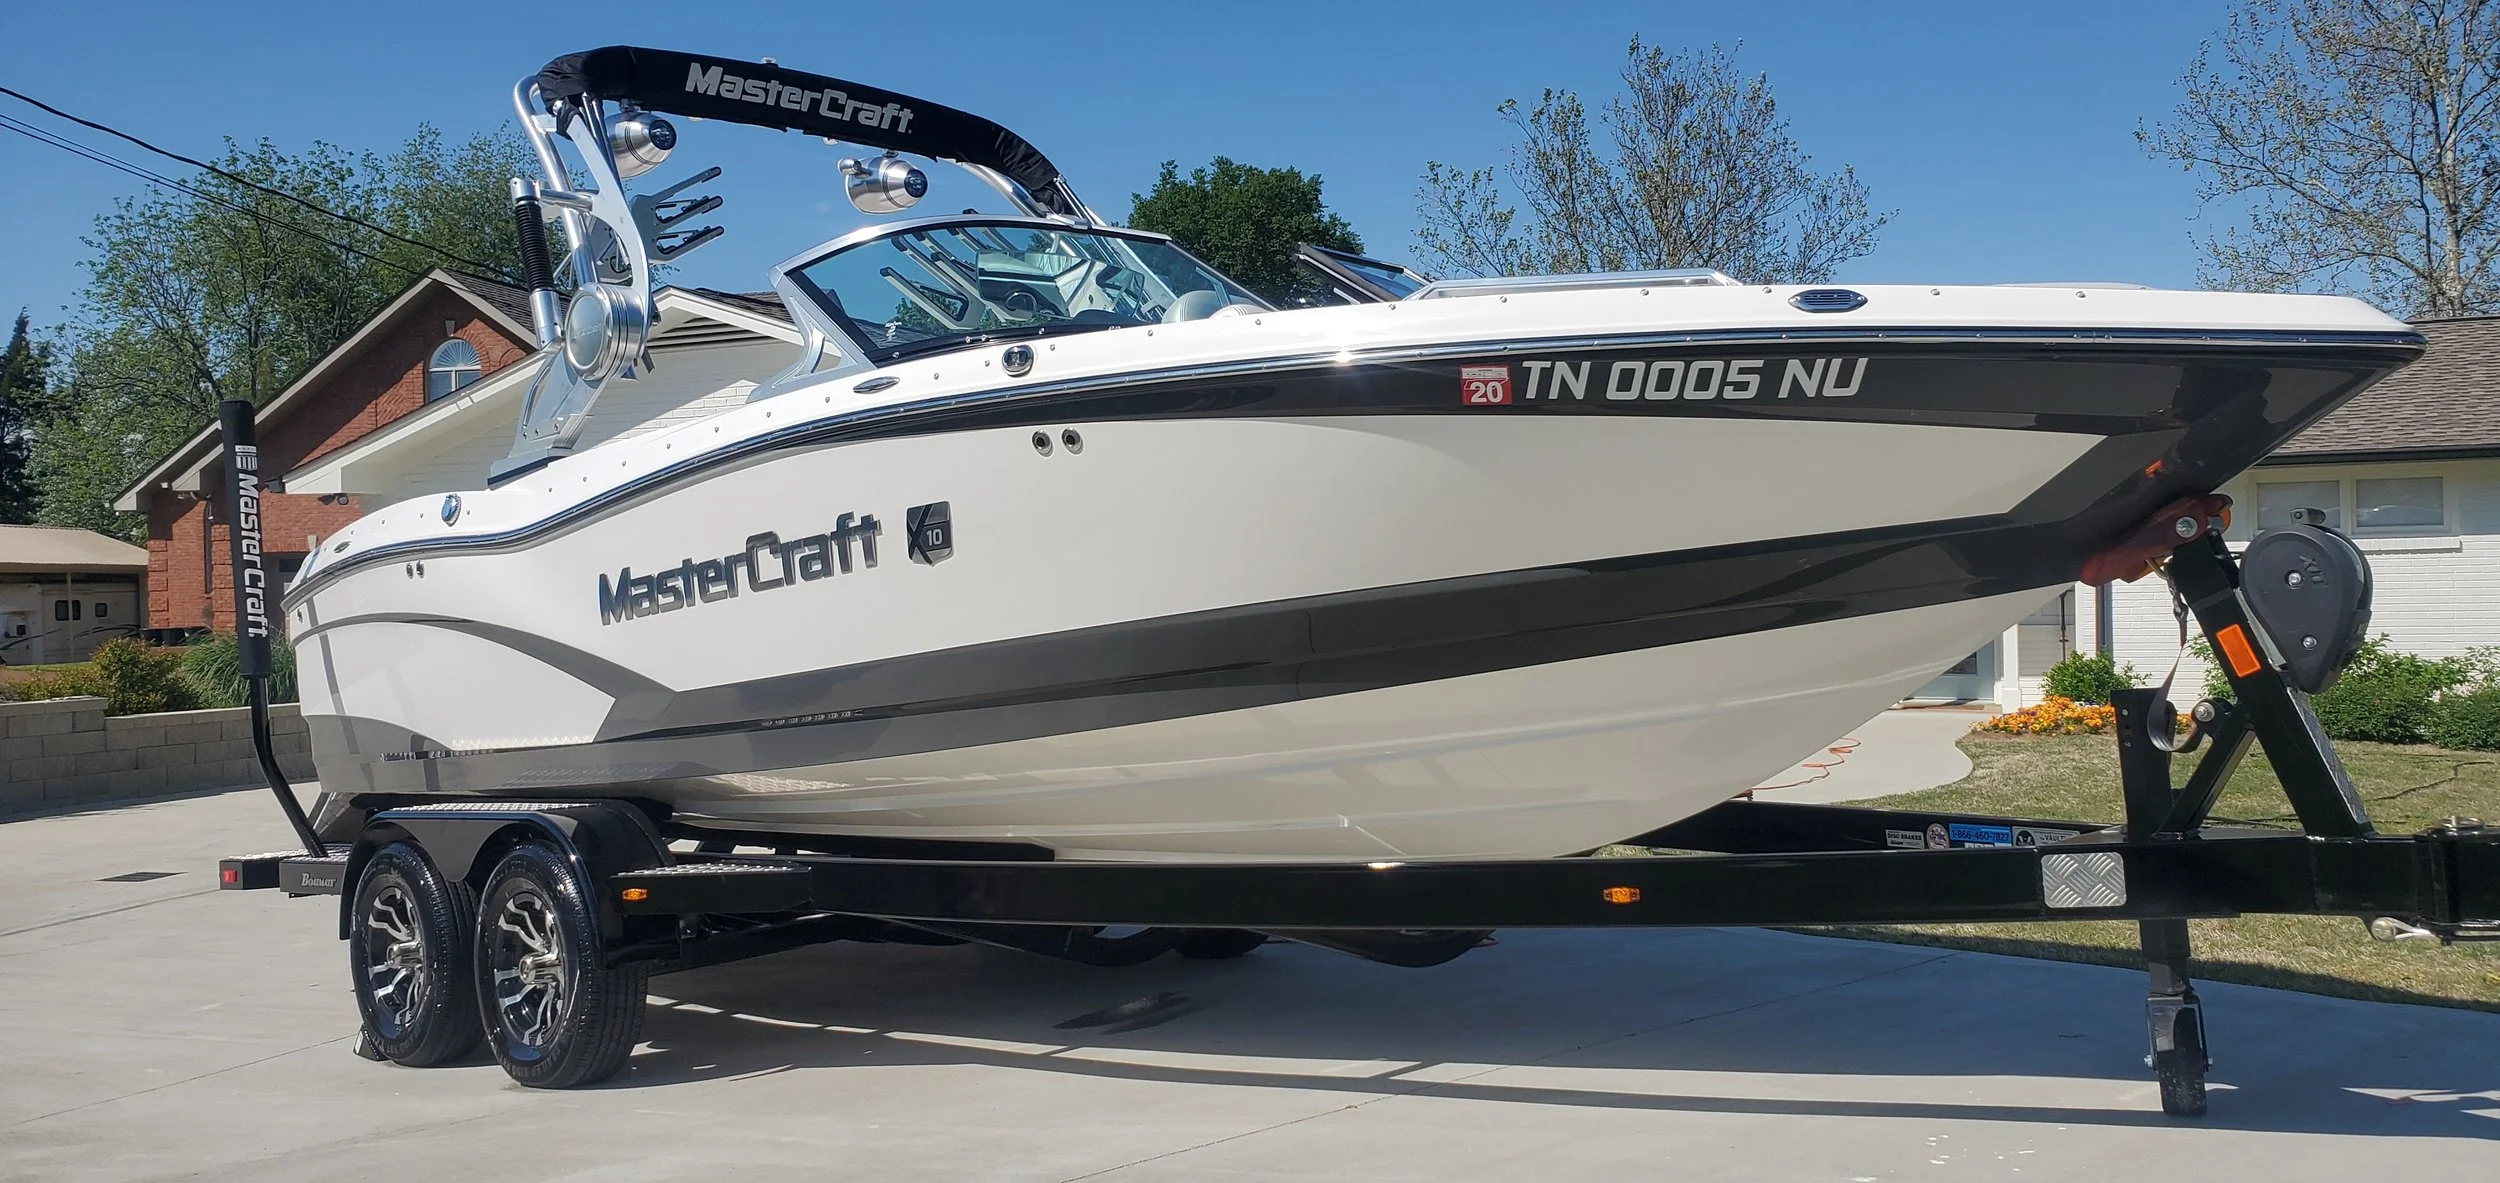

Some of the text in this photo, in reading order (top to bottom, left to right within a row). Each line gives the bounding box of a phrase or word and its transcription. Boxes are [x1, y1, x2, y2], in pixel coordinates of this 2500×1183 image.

[685, 61, 914, 133] MasterCraft
[1470, 381, 1503, 403] 20
[1521, 357, 1869, 401] TN 0005 NU
[238, 473, 268, 638] MasterCraft
[598, 510, 884, 626] MasterCraft
